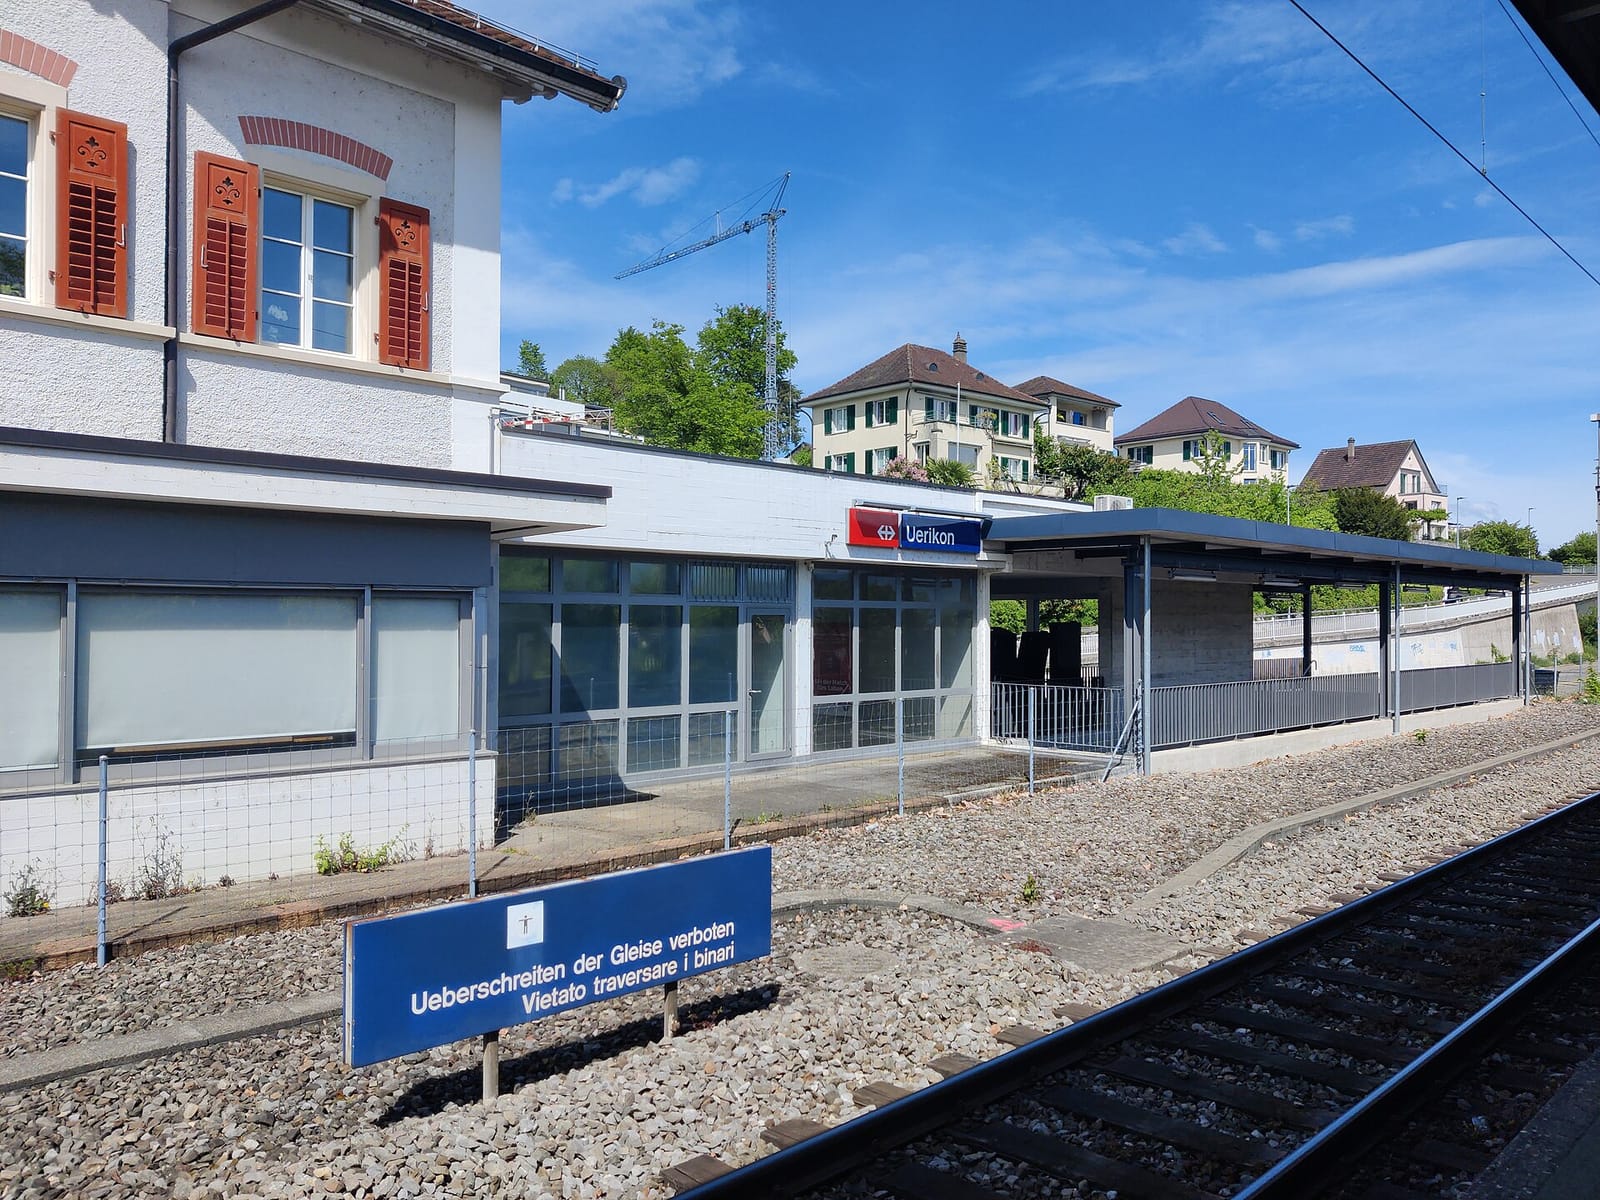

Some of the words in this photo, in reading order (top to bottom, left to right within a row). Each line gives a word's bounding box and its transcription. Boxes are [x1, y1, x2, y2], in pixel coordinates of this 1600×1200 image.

[906, 525, 955, 546] Uerikon
[411, 963, 566, 1016] Ueberschreiten
[573, 952, 604, 976] der
[610, 938, 663, 966] Gleise
[669, 919, 735, 951] verboten
[521, 982, 588, 1015] Vietato
[593, 959, 678, 996] traversare
[683, 952, 689, 973] i
[694, 940, 735, 970] binari
